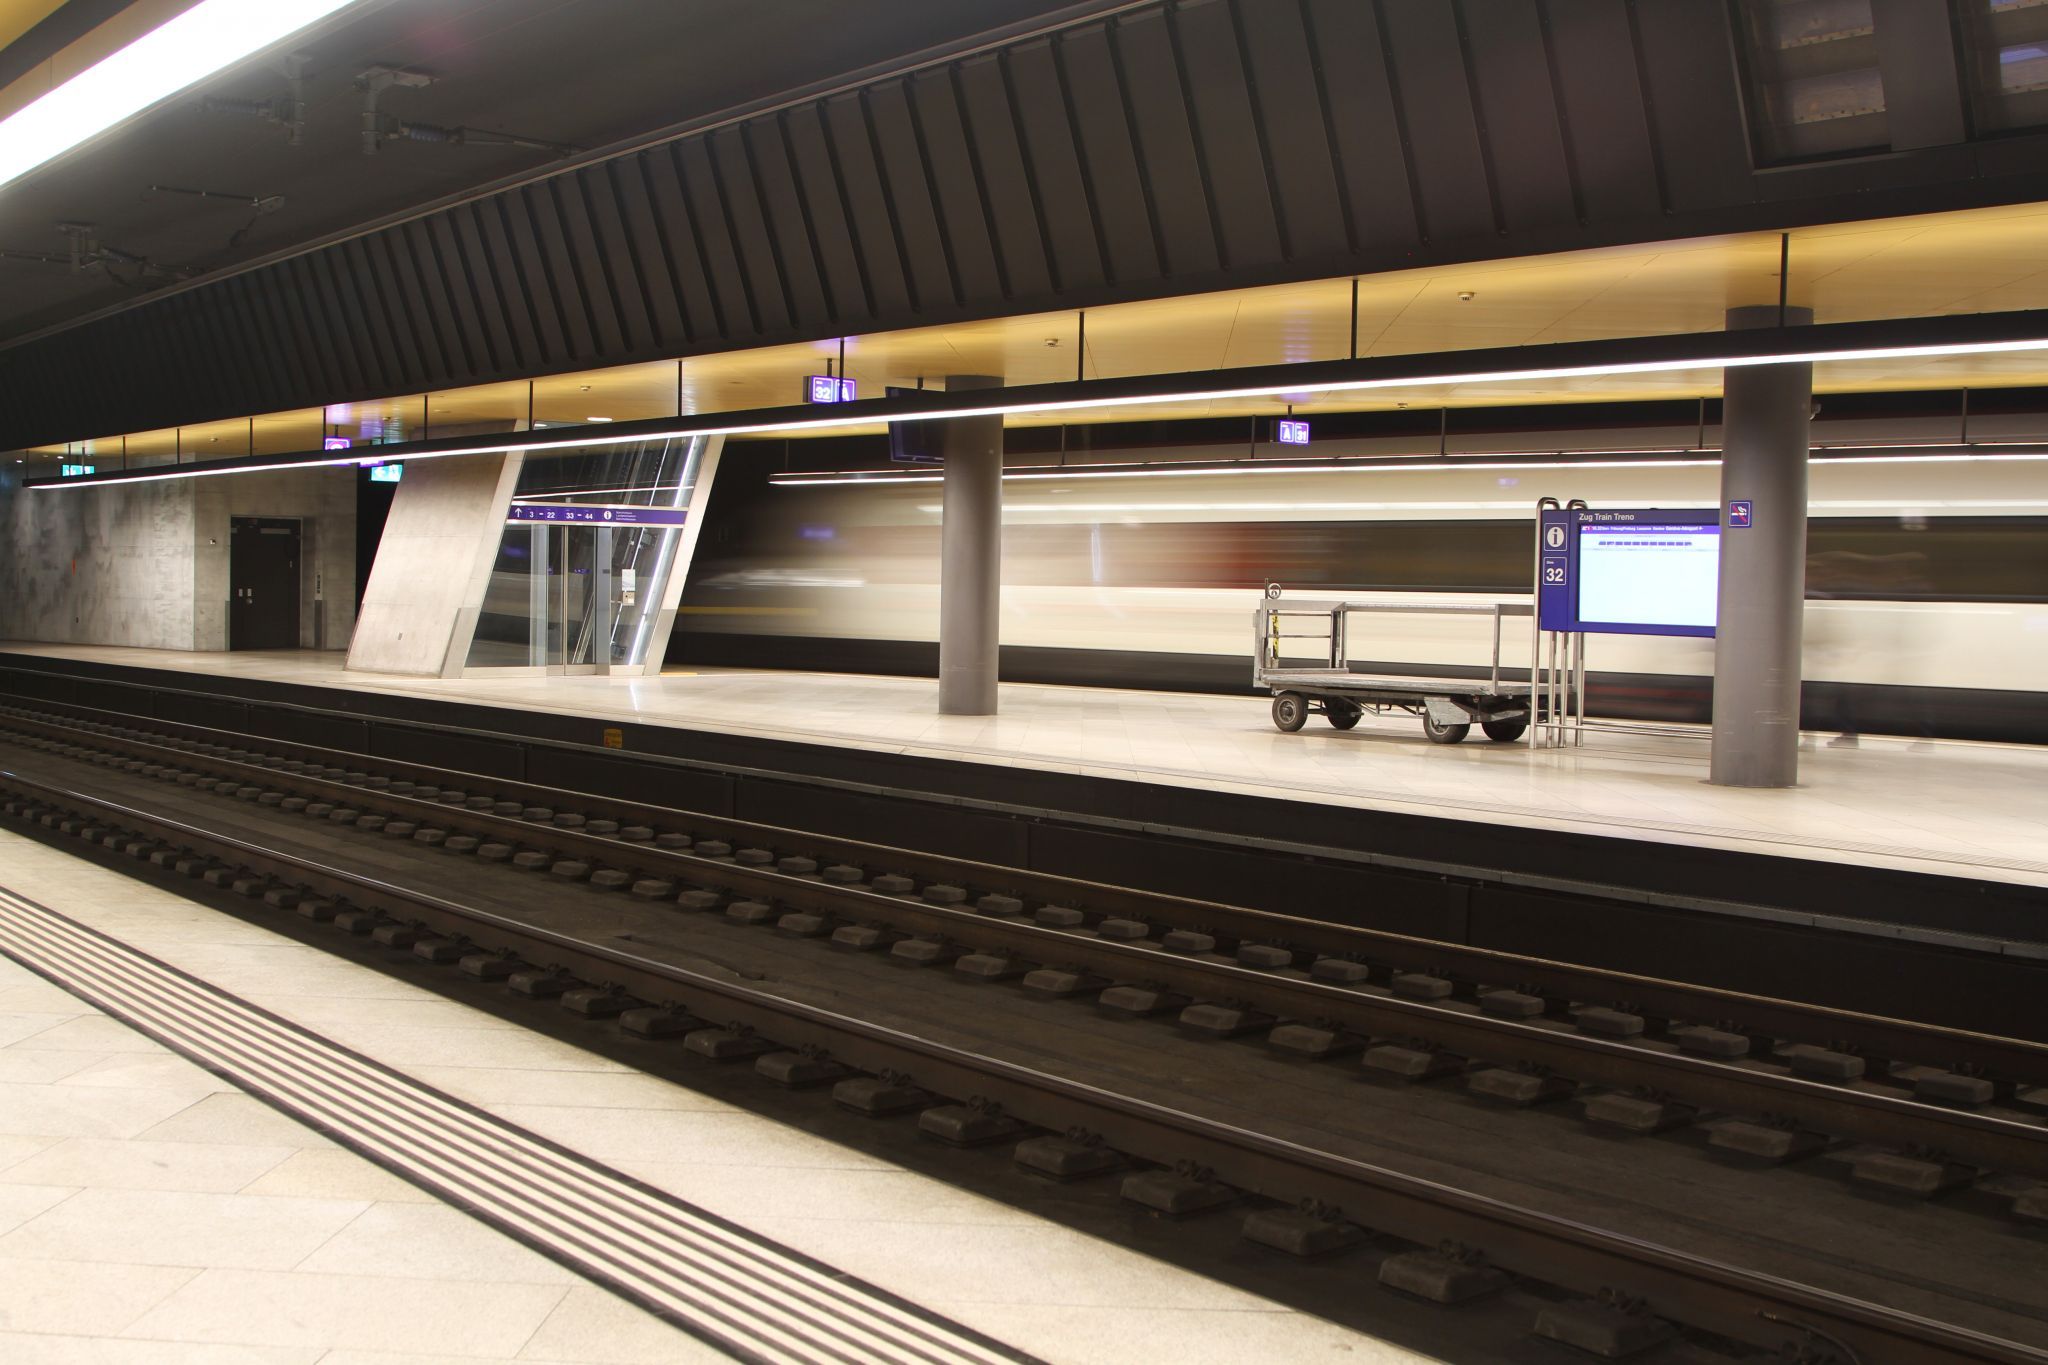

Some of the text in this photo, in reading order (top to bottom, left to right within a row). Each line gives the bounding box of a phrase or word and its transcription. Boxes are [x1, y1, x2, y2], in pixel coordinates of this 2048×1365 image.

[815, 386, 831, 399] 32
[1283, 427, 1291, 440] A
[1297, 430, 1307, 441] 31
[546, 511, 556, 519] 22
[566, 512, 574, 520] 33
[1579, 513, 1635, 522] Zug Train Treno
[1546, 567, 1564, 582] 32
